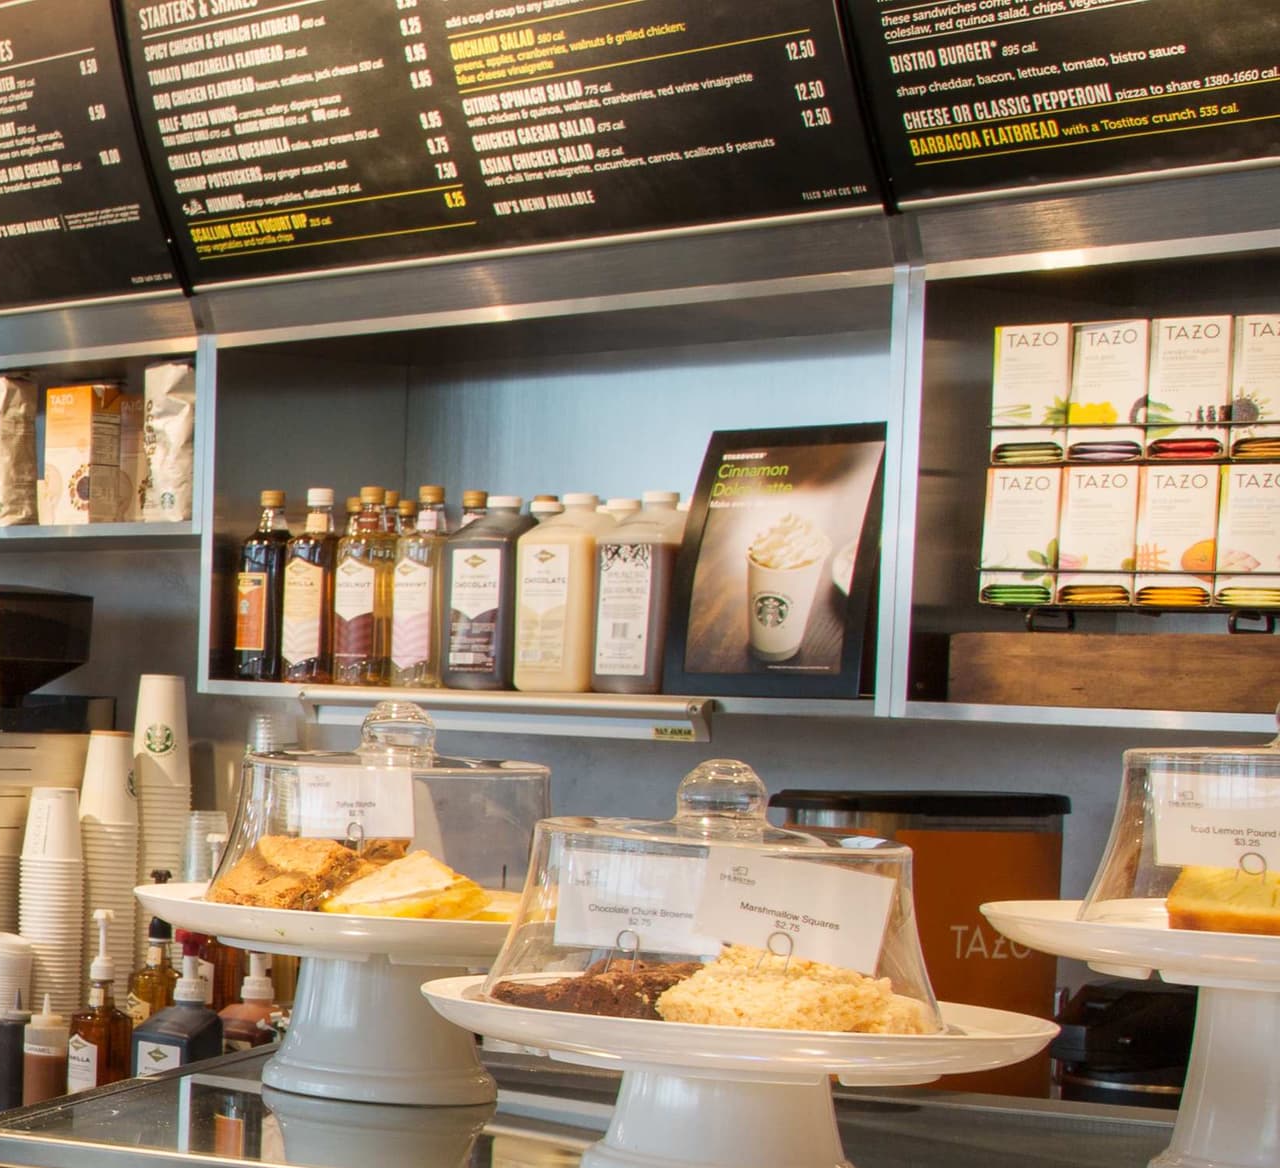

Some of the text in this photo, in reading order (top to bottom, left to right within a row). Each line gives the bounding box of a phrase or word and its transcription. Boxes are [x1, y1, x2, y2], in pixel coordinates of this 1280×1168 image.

[139, 0, 196, 31] STARTERS
[881, 1, 976, 26] these sandwiches
[884, 24, 932, 39] coleslaw,
[935, 19, 952, 31] red
[956, 13, 995, 28] quinoa
[998, 7, 1030, 21] salad,
[1032, 1, 1066, 15] chips,
[449, 28, 535, 60] ORCHARD SALAD
[785, 38, 816, 61] 12.50
[890, 42, 1038, 74] BISTRO 895 cal.
[896, 44, 1186, 97] sharp cheddar, bacon, lettuce, tomato, bistro sauce
[462, 80, 584, 116] CITRUS SPINACH SALAD
[487, 72, 753, 125] chicken red wine vinaigrette
[794, 79, 825, 102] 12.50
[903, 66, 1280, 130] CHEESE OR CLASSIC PEPPERONI pizza to share 1380-1660 cal.
[800, 106, 832, 128] 12.50
[472, 117, 596, 152] CHICKEN CAESAR SALAD
[909, 103, 1239, 156] BARBACOA FLATBREAD with a crunch 535 cal.
[480, 143, 594, 176] ASIAN CHICKEN SALAD
[648, 137, 776, 165] carrots, scallions peanuts
[546, 190, 596, 209] AVAILABLE
[1007, 331, 1059, 349] TAZO
[1087, 328, 1138, 347] TAZO
[1165, 323, 1221, 341] TAZO
[718, 464, 789, 478] Cinnamon
[1076, 473, 1128, 489] TAZO
[1153, 474, 1208, 489] TAZO
[1000, 476, 1051, 491] TAZO
[1213, 827, 1276, 838] Lemon Pound
[588, 903, 658, 916] Chocolate Chunk
[740, 900, 841, 931] Marshmallow Squares
[775, 920, 801, 933] $2.75
